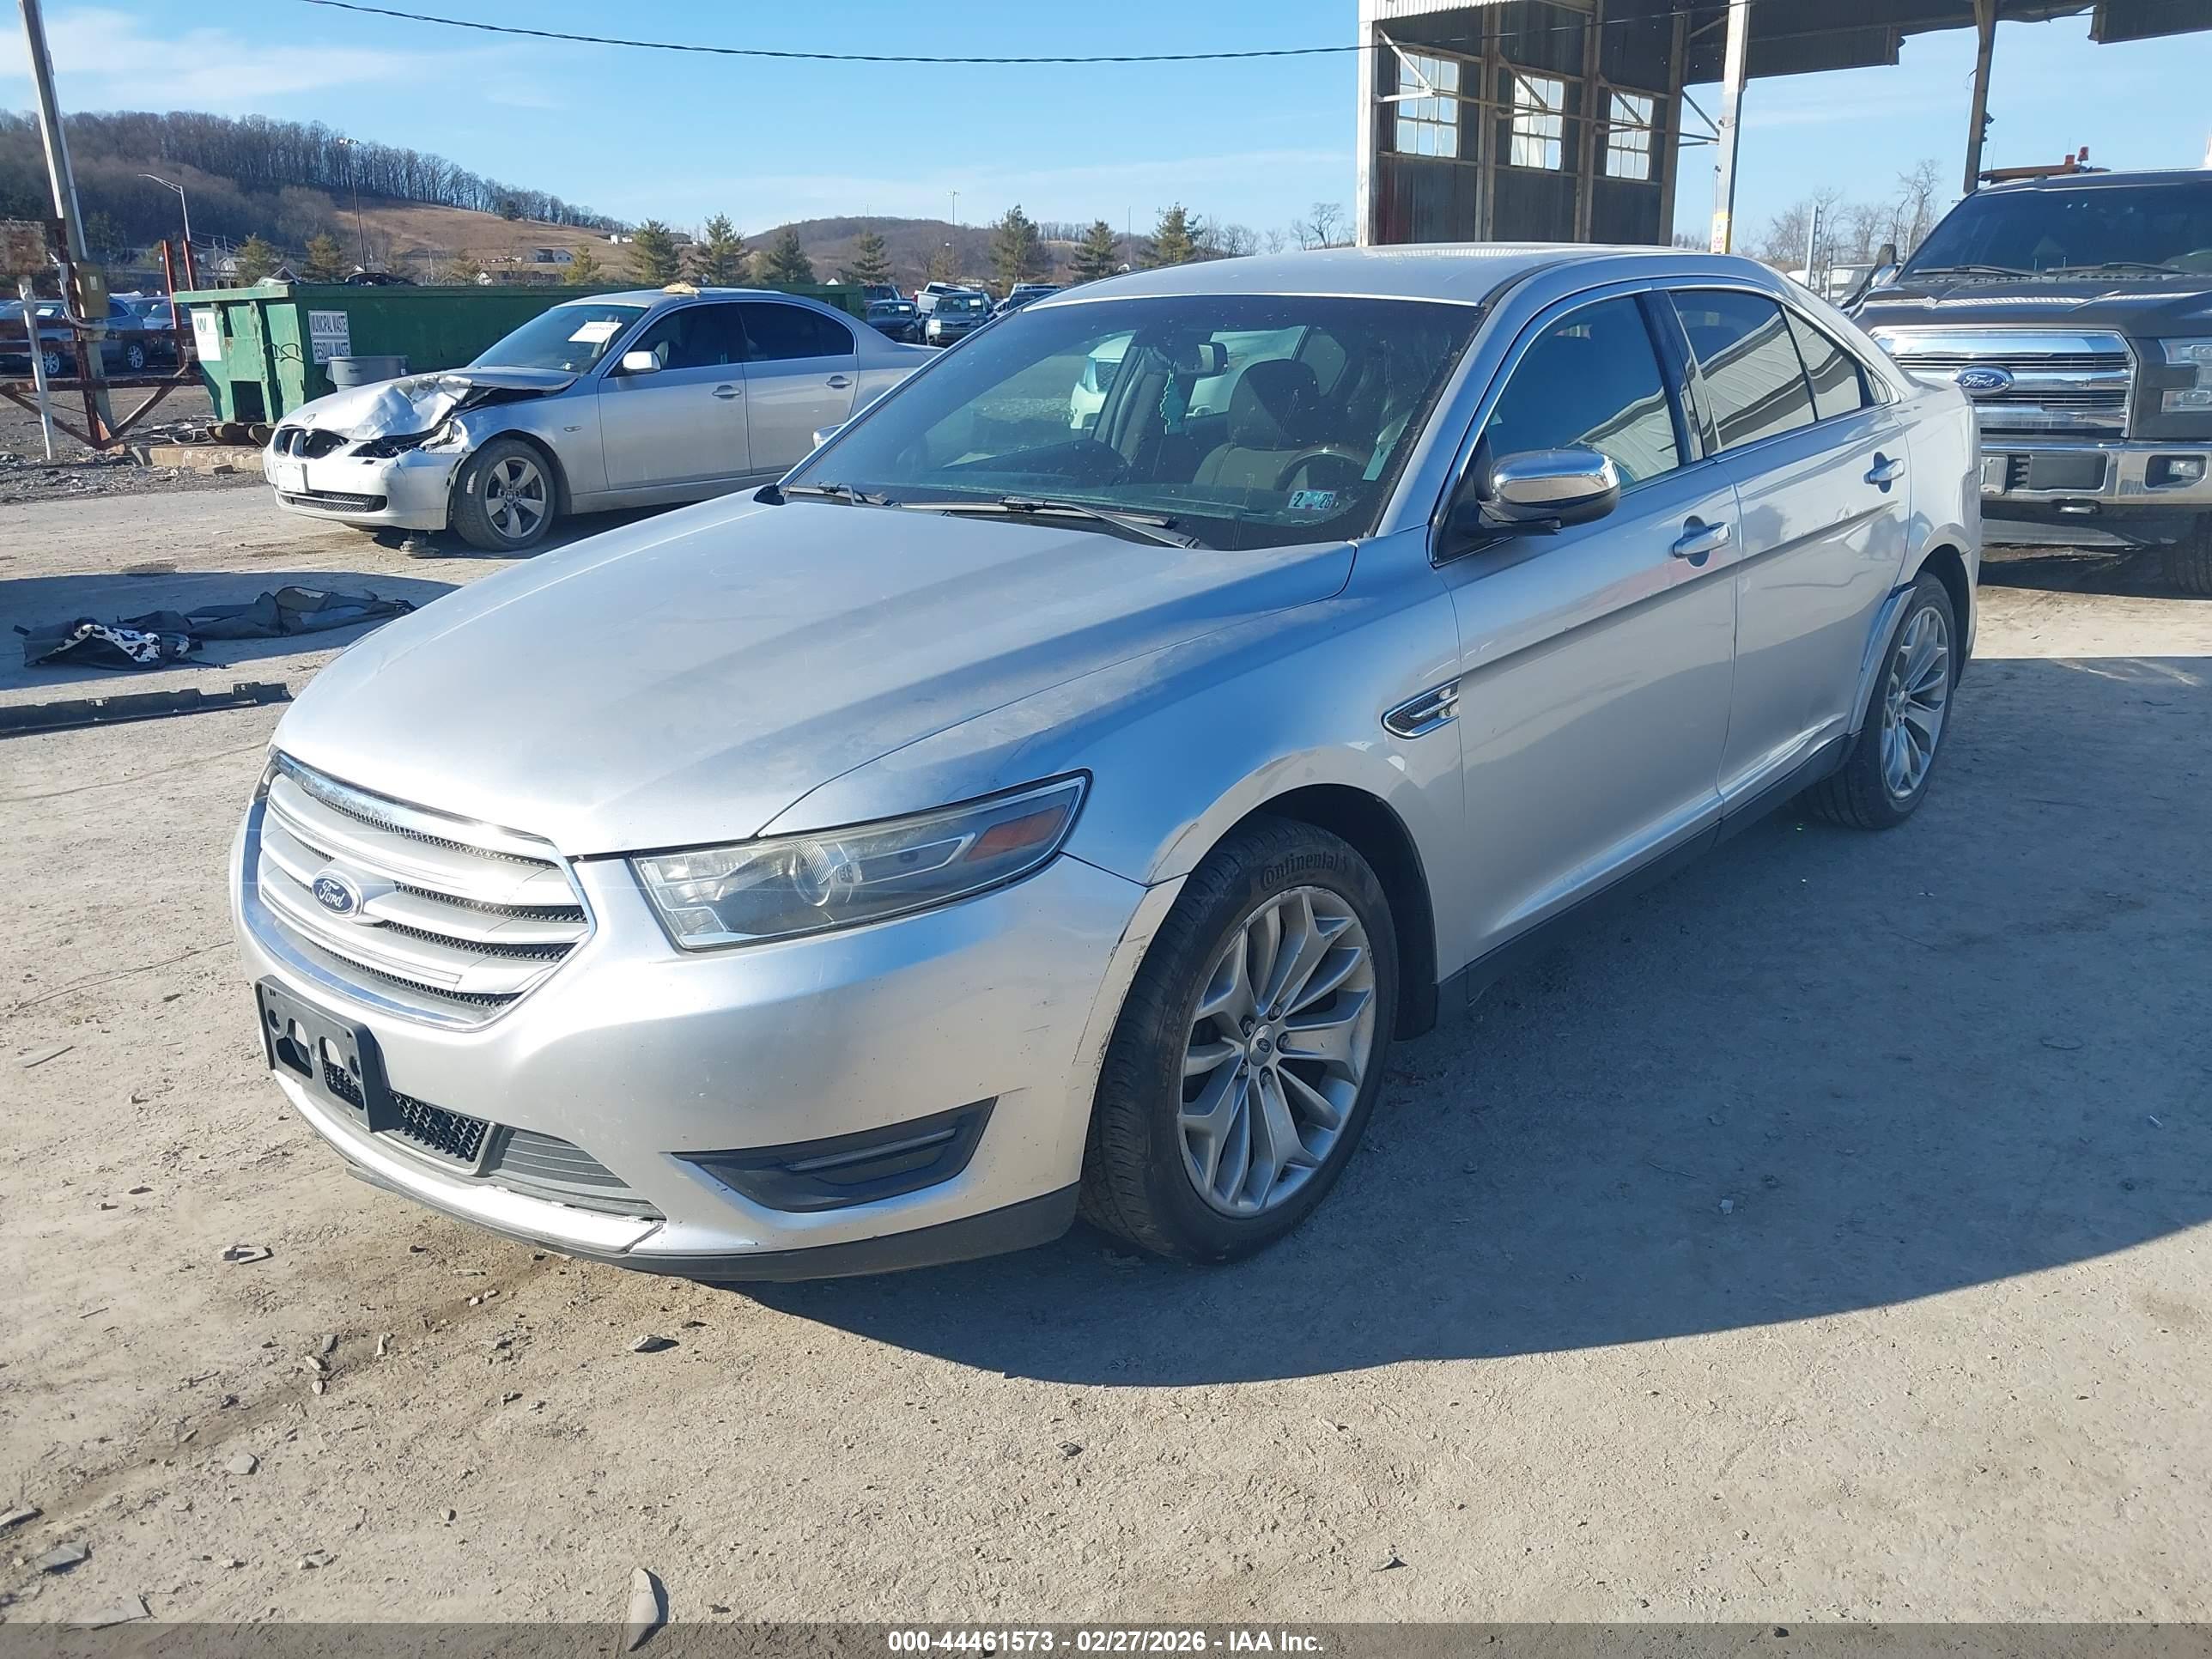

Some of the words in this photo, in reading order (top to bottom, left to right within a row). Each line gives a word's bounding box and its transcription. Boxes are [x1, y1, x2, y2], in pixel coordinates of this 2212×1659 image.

[311, 314, 333, 333] MUNICIPAL
[332, 314, 347, 333] WASTE
[335, 342, 349, 357] WASTE
[1962, 374, 1996, 387] Ford
[1293, 491, 1304, 507] 2
[1319, 493, 1334, 509] 26
[1260, 851, 1340, 891] Continental
[319, 879, 346, 908] Ford
